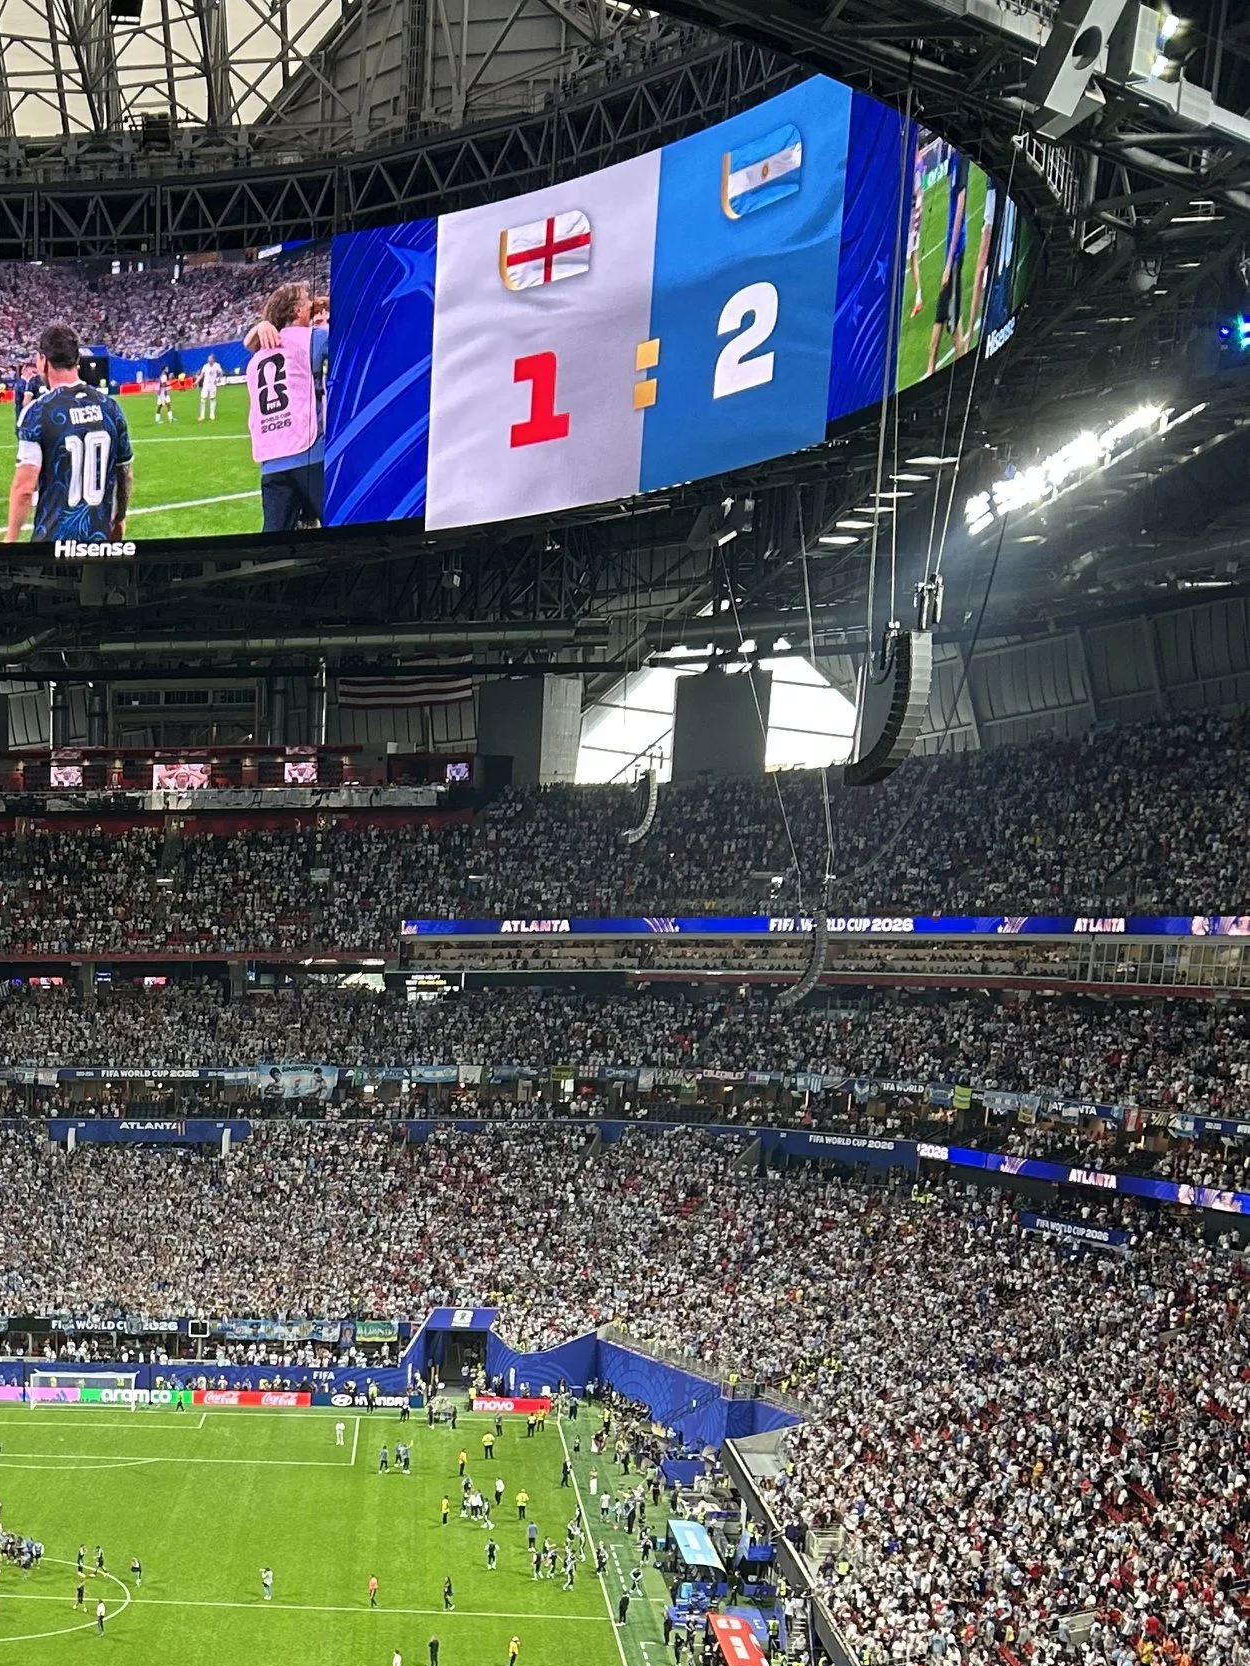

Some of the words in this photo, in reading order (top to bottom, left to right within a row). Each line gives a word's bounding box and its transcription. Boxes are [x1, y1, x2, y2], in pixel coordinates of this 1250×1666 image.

[510, 350, 571, 449] 1
[712, 281, 779, 400] 2
[68, 405, 104, 425] MESSI
[261, 419, 292, 434] 2026
[65, 430, 111, 507] 10
[54, 540, 136, 558] Hisense
[501, 919, 570, 932] ATLANTA
[846, 918, 871, 932] CUP
[871, 917, 914, 932] 2026
[1073, 918, 1125, 932] ATLANTA
[151, 1069, 169, 1077] CUP
[170, 1069, 200, 1077] 2026
[809, 1134, 825, 1143] FIFA
[825, 1137, 852, 1146] WORLD
[852, 1139, 867, 1147] CUP
[868, 1141, 895, 1151] 2026
[920, 1143, 949, 1160] 2026
[1068, 1168, 1117, 1189] ATLANTA
[1085, 1229, 1110, 1242] 2026
[76, 1320, 116, 1331] WORLD
[312, 1371, 335, 1380] FIFA
[100, 1390, 171, 1403] aramco
[203, 1391, 240, 1405] Coca-Cola
[261, 1392, 298, 1406] Coca-Cola
